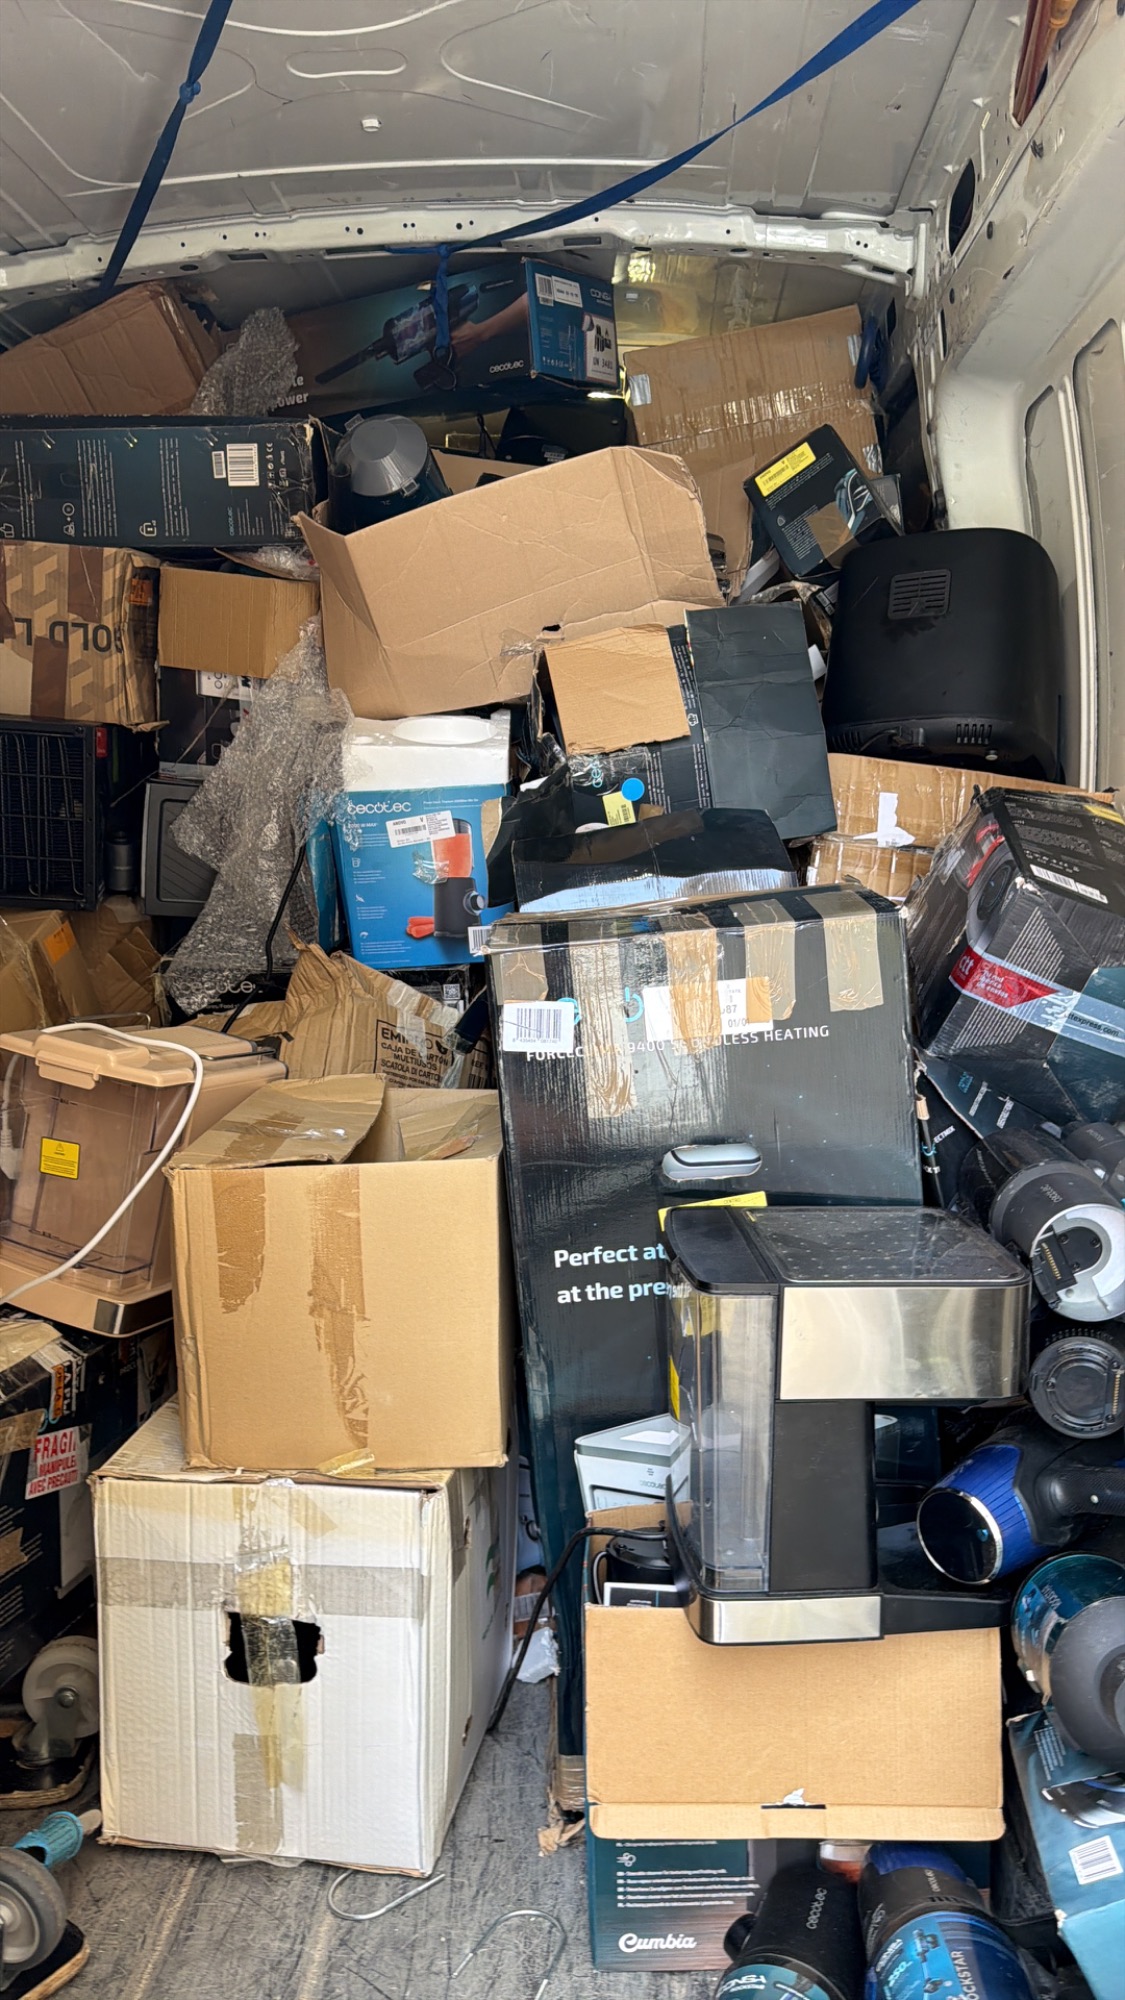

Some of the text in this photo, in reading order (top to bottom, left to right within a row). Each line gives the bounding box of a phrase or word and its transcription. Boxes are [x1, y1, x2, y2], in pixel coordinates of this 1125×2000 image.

[347, 800, 412, 815] cecotec
[180, 980, 256, 993] cecote
[1065, 1010, 1120, 1038] ttexpress.com
[381, 1042, 404, 1054] CAJA
[405, 1047, 417, 1056] DE
[628, 1037, 665, 1055] 9400
[764, 1025, 830, 1043] HEATING
[381, 1060, 410, 1074] SCATOLA
[418, 1070, 441, 1083] CARTO
[393, 1053, 438, 1071] MULTIUSOS
[554, 1243, 669, 1268] Perfect at
[557, 1285, 581, 1304] at
[585, 1282, 623, 1301] the
[38, 1455, 76, 1477] MANIPULE
[28, 1479, 46, 1496] AVEC
[806, 1887, 827, 1929] cecotec
[618, 1932, 698, 1953] Cumbia
[950, 1951, 980, 2000] OCKSTAR
